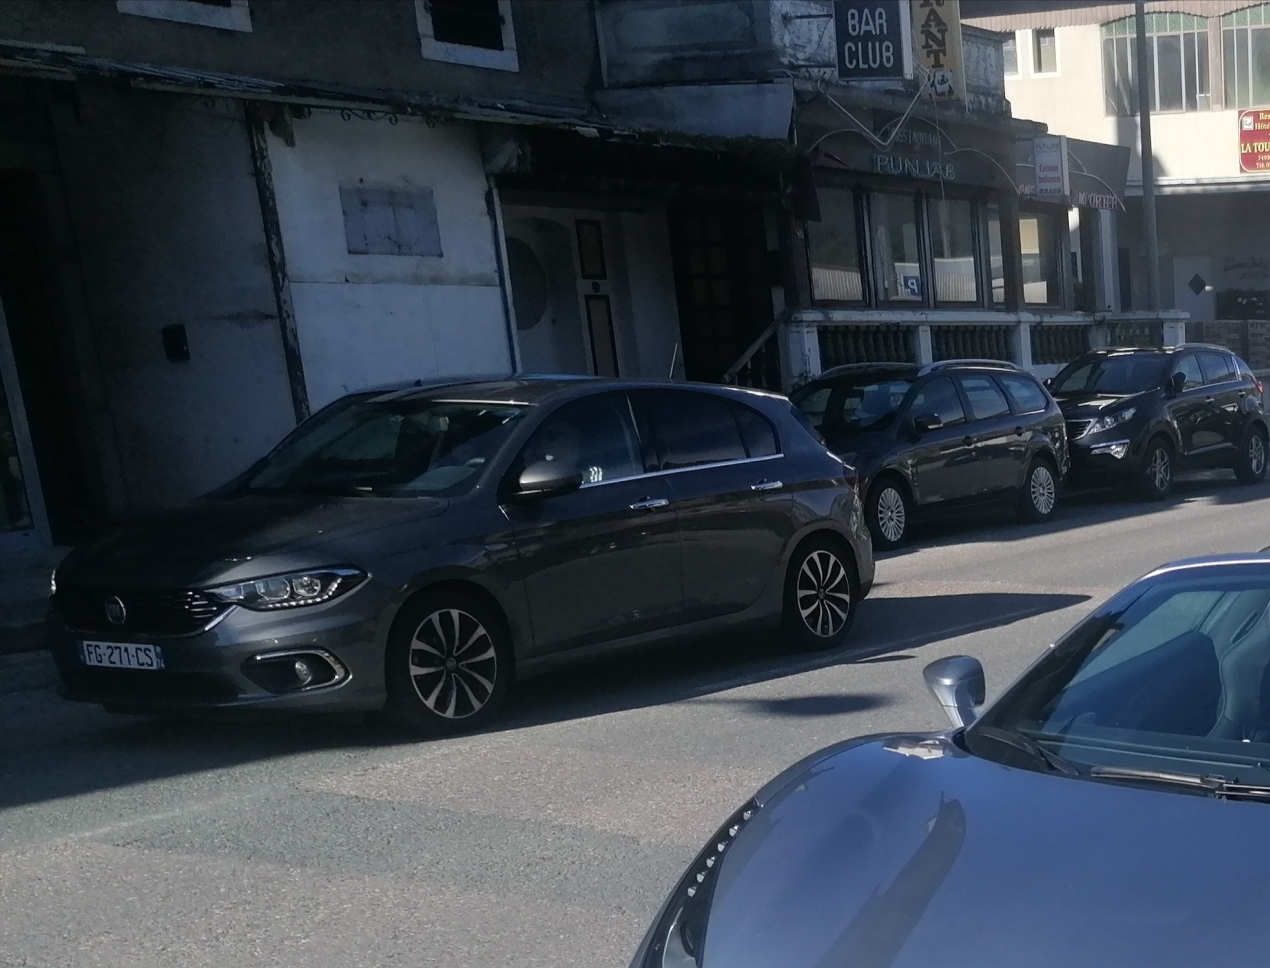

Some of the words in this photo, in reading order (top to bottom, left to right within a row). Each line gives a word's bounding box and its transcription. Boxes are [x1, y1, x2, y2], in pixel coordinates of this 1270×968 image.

[847, 7, 888, 36] BAR
[844, 40, 894, 69] CLUB
[1241, 143, 1252, 153] LA
[873, 153, 956, 180] PUNJAB
